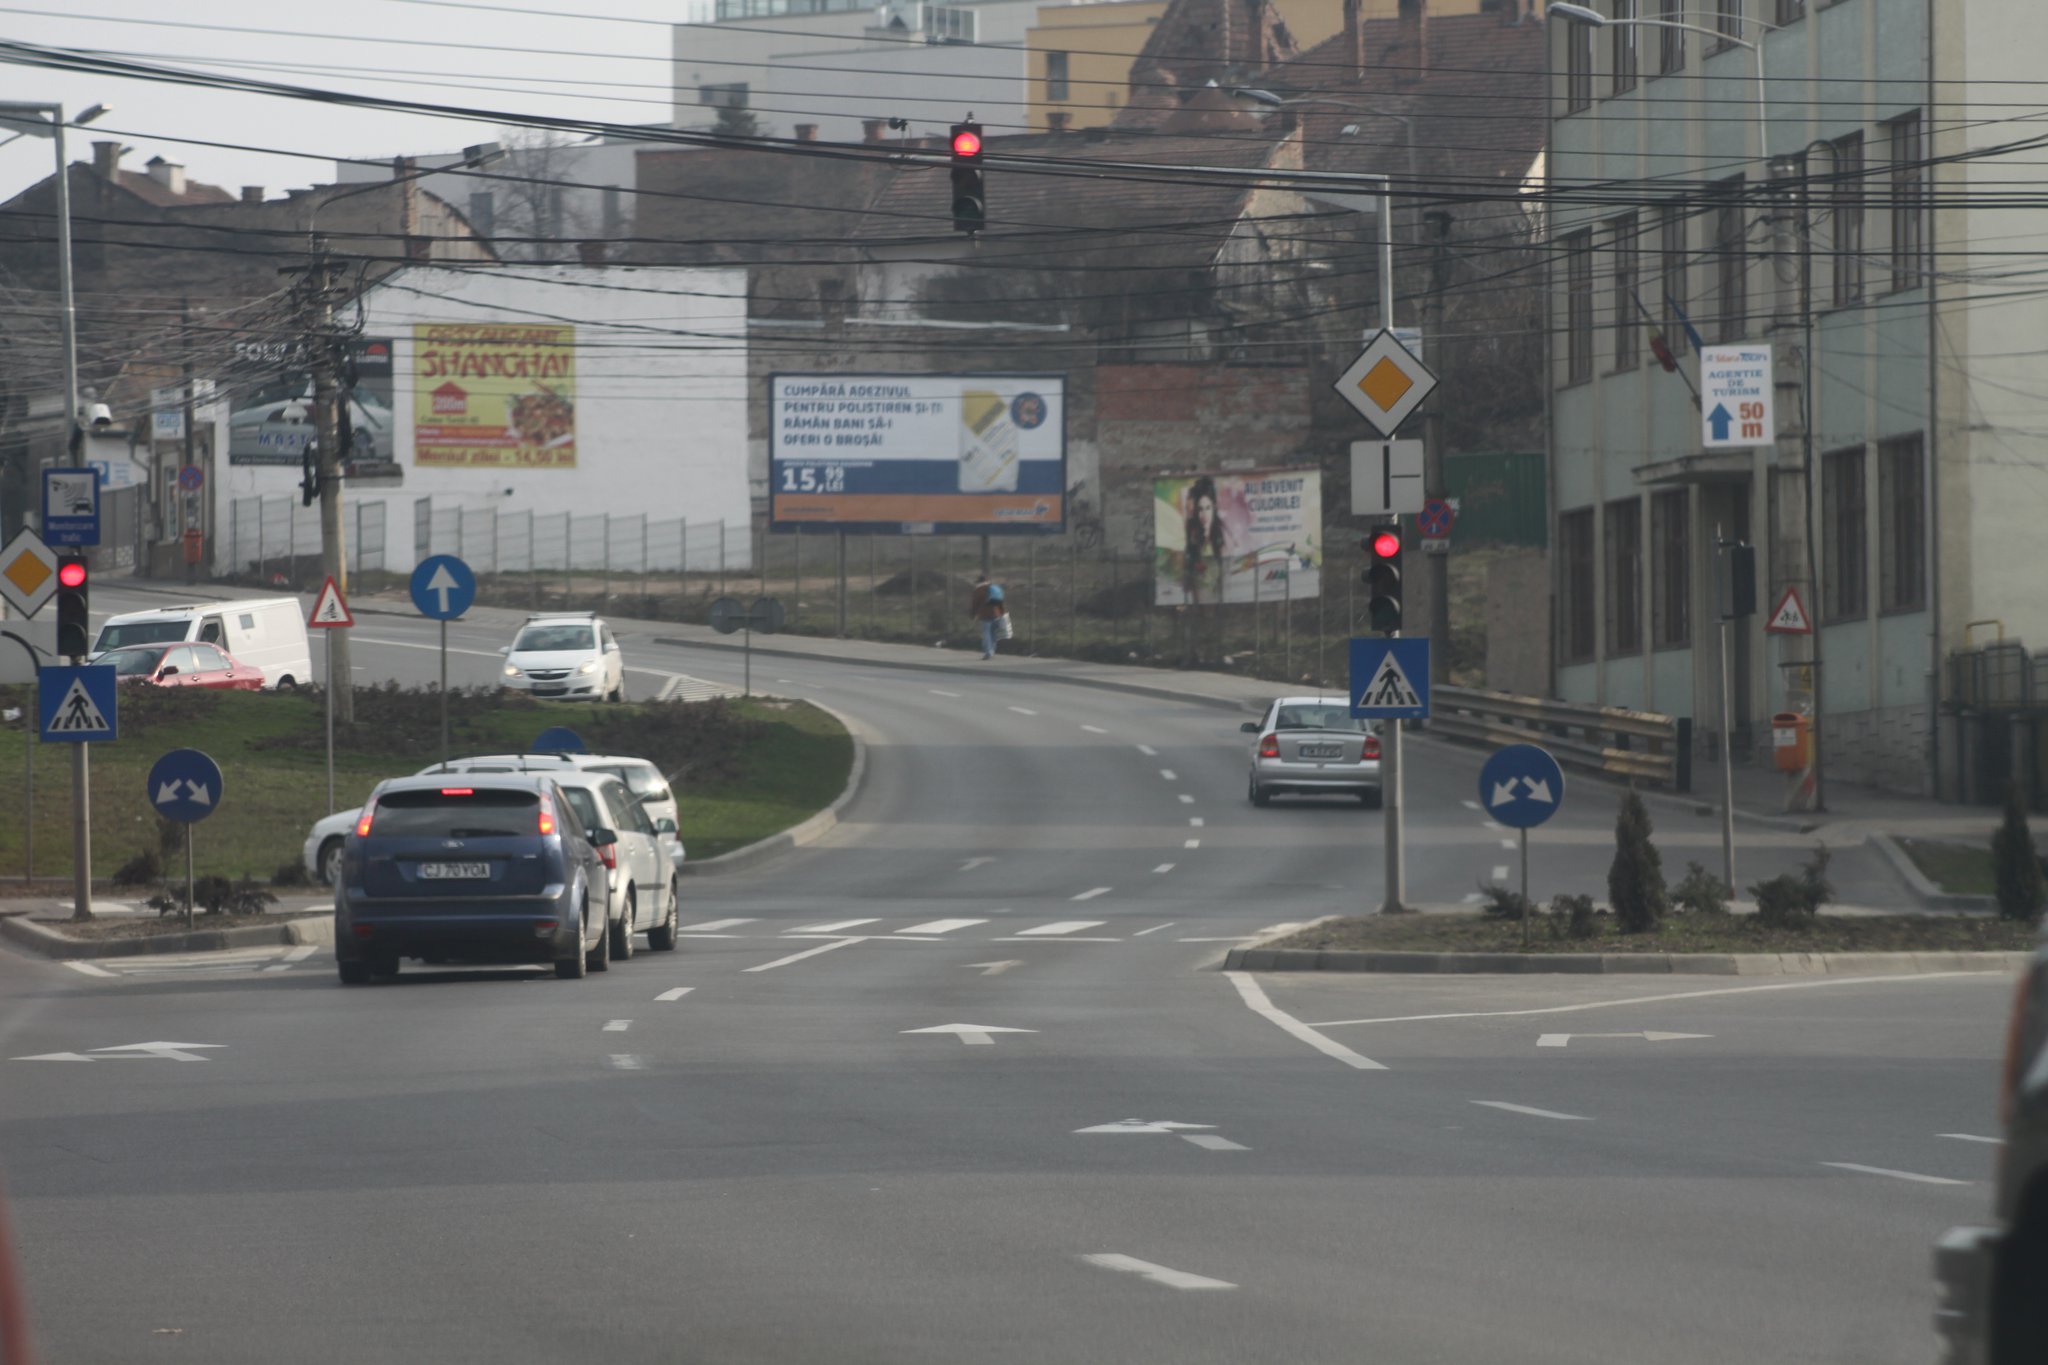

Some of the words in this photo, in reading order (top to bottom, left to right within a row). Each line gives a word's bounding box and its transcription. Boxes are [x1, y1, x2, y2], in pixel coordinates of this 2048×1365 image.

[420, 350, 570, 378] SHANGHAI
[1708, 369, 1763, 379] AGENTIE
[1727, 379, 1744, 388] DE
[849, 385, 911, 397] ADEZIVUL
[1711, 387, 1760, 397] TURISM
[784, 402, 834, 413] PENTRU
[838, 402, 911, 414] POLISTIREN
[1739, 401, 1764, 420] 50
[834, 418, 864, 429] BANI
[1741, 422, 1763, 438] m
[784, 433, 820, 446] OFERI
[824, 434, 832, 446] O
[825, 480, 845, 491] LEI
